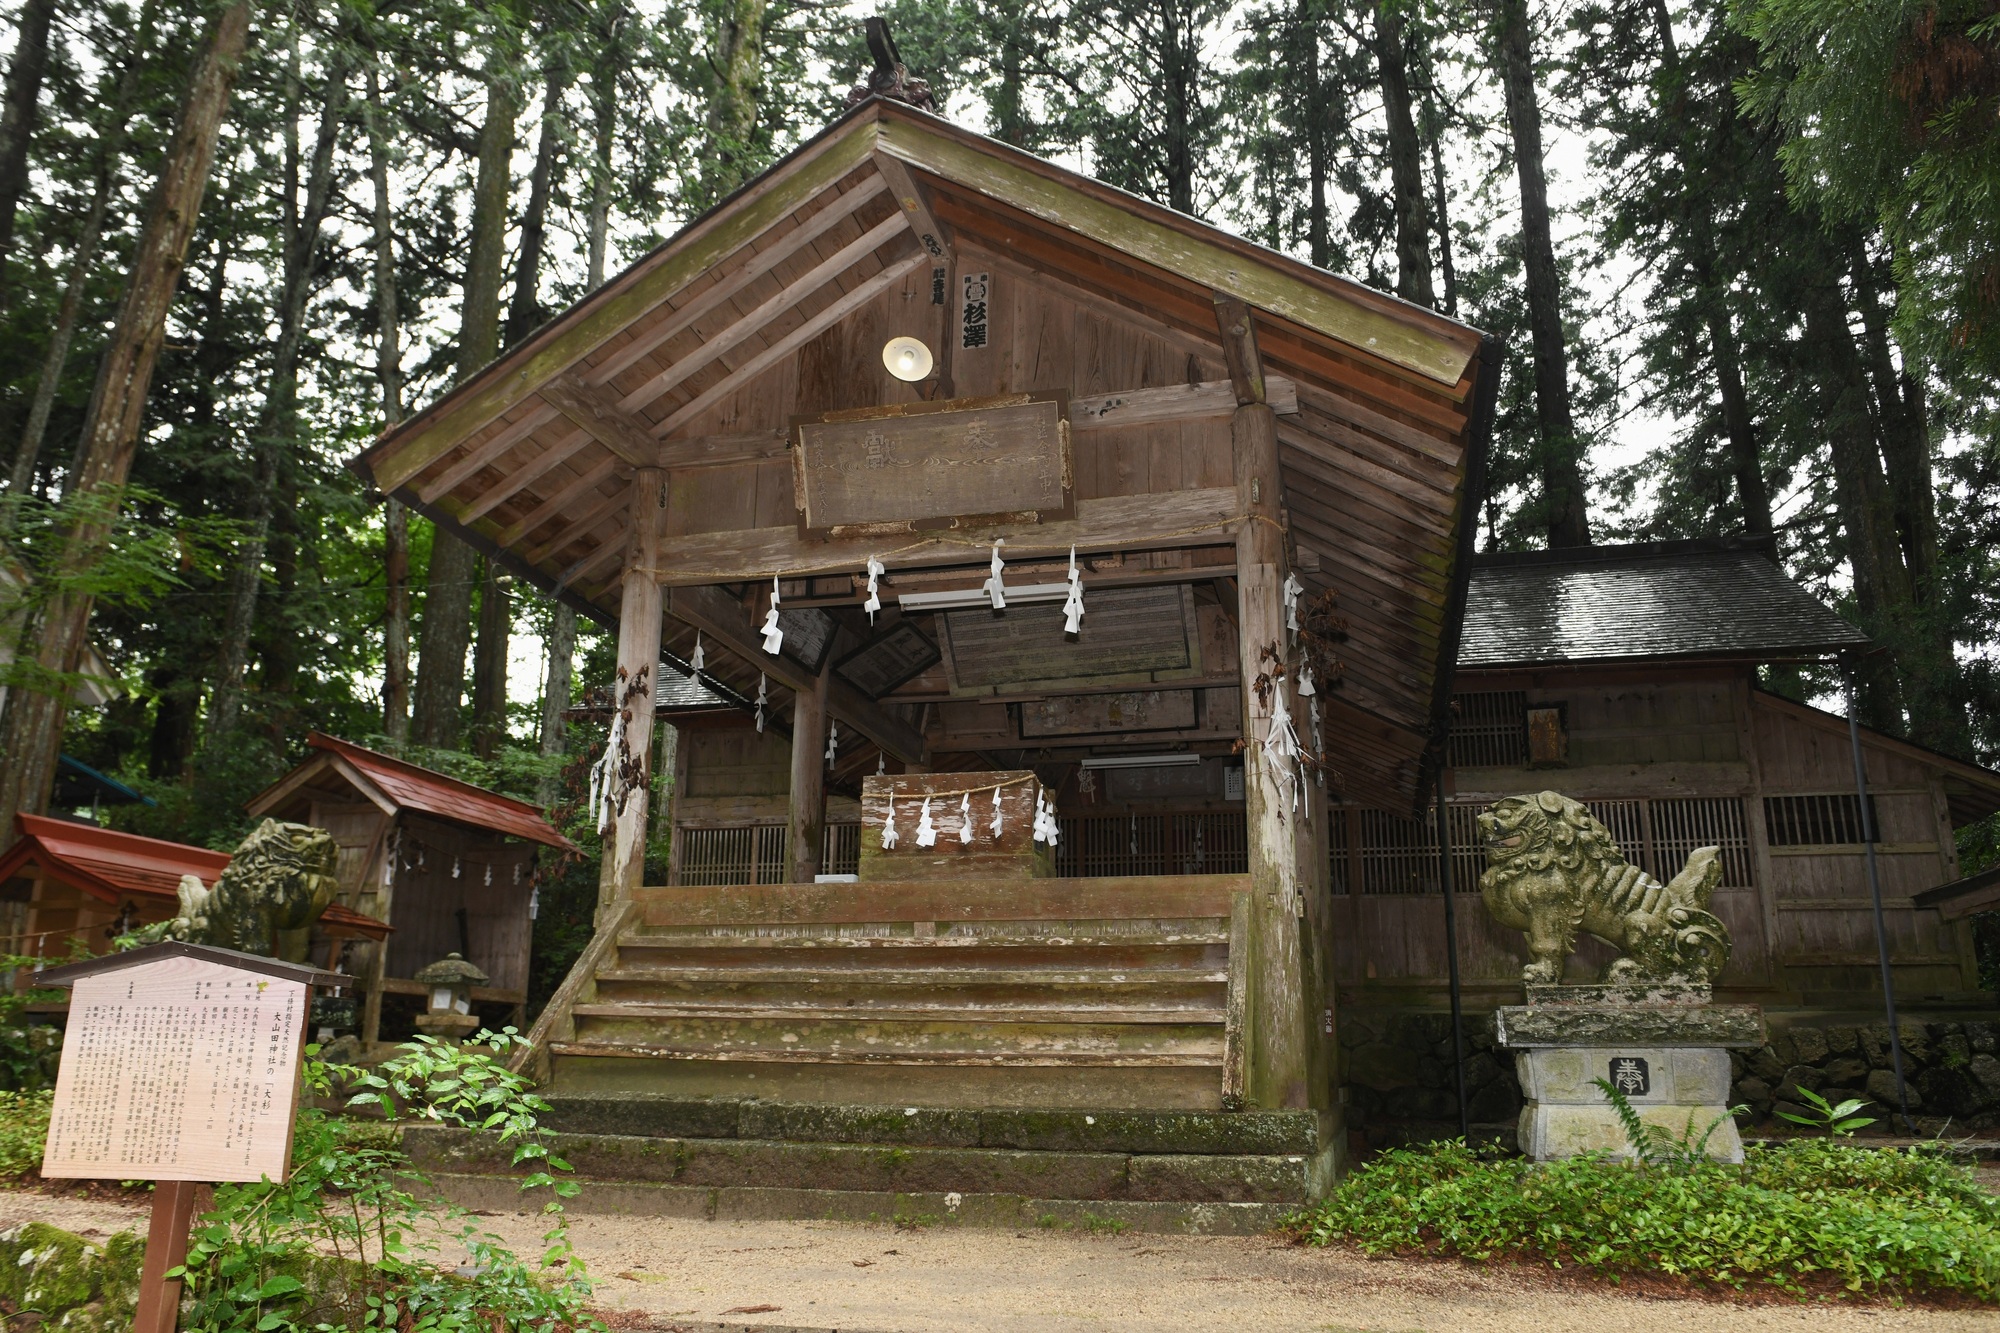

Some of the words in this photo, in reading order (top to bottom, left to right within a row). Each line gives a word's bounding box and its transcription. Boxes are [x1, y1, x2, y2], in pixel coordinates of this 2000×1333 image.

[260, 1011, 281, 1115] 大山田神社の「大杉」
